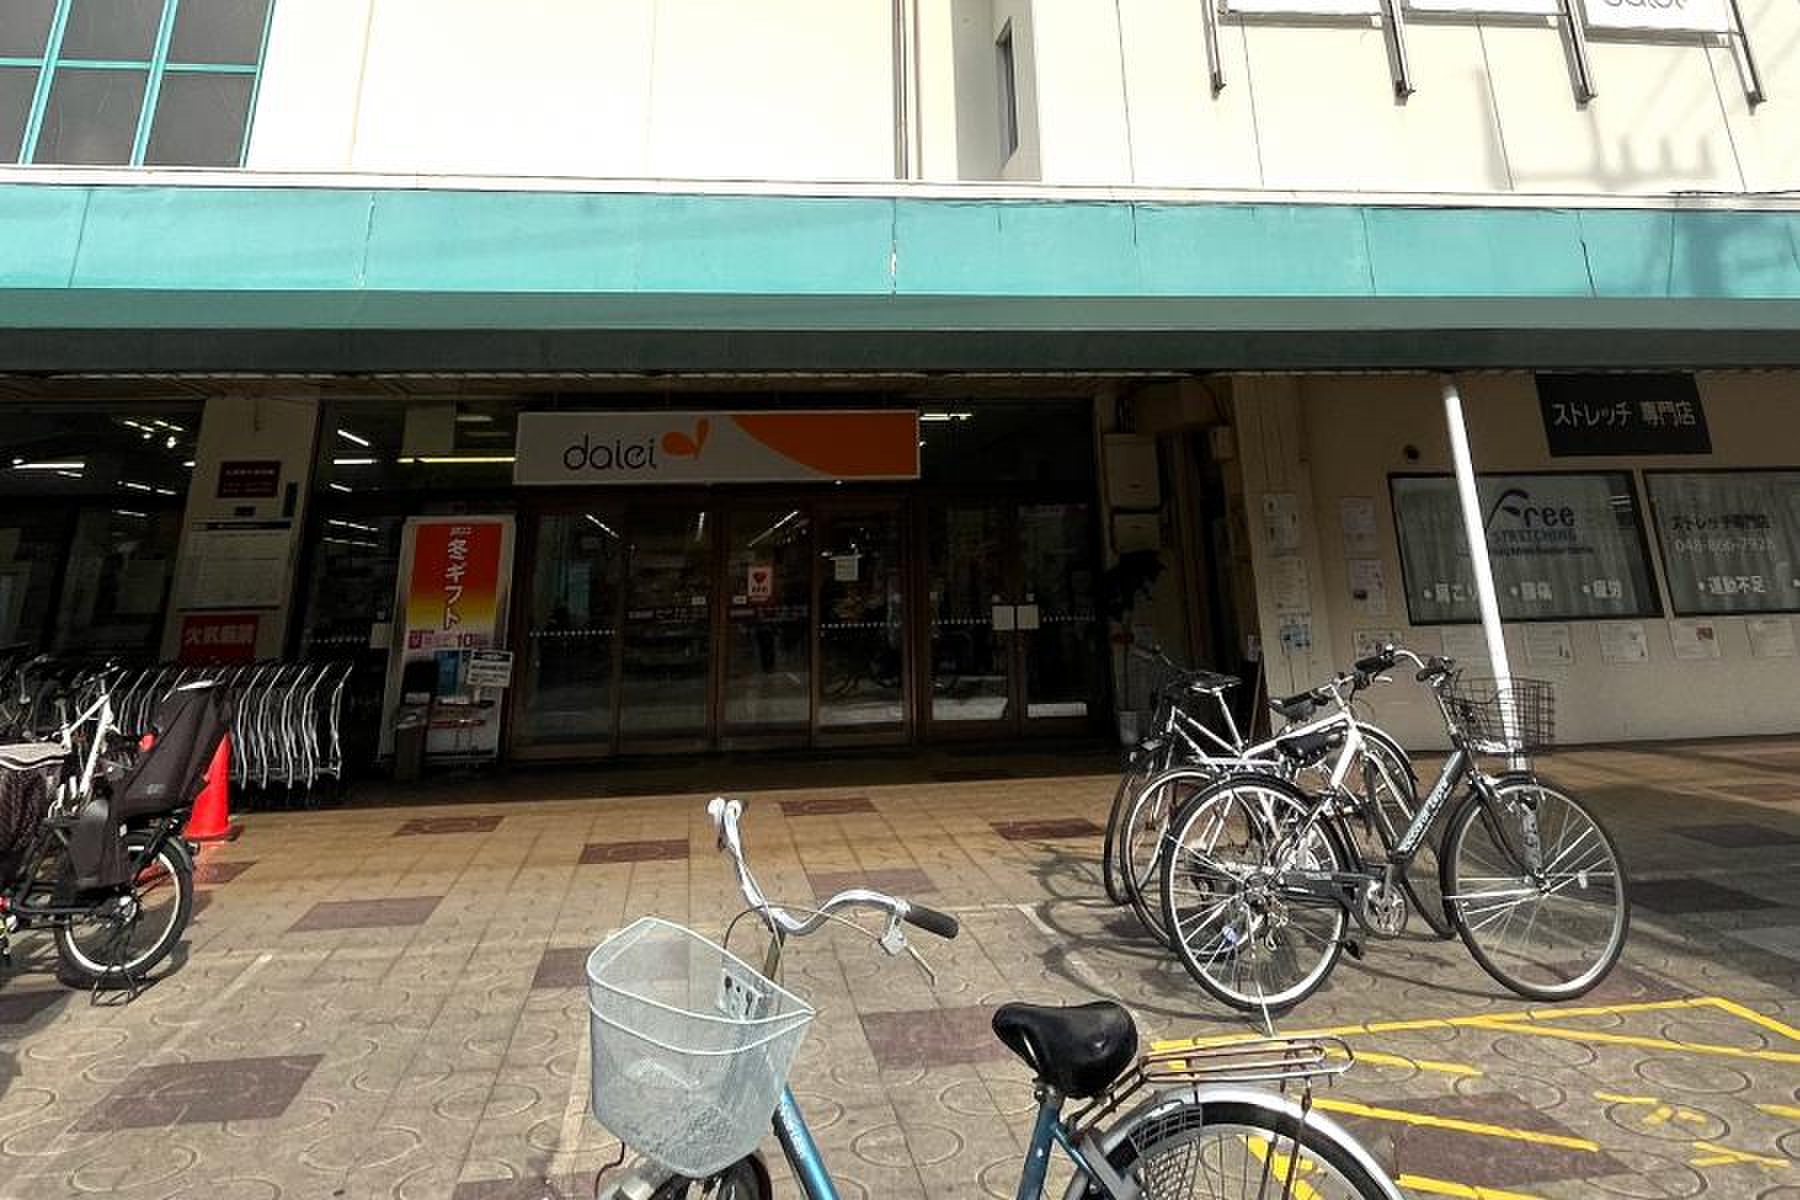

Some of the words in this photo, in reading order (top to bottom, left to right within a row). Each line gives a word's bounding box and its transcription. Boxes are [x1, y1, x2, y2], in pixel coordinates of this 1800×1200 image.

[1551, 402, 1633, 427] ストレッチ
[1640, 400, 1697, 427] 専門店
[563, 434, 657, 471] daiei
[1486, 488, 1576, 529] Free
